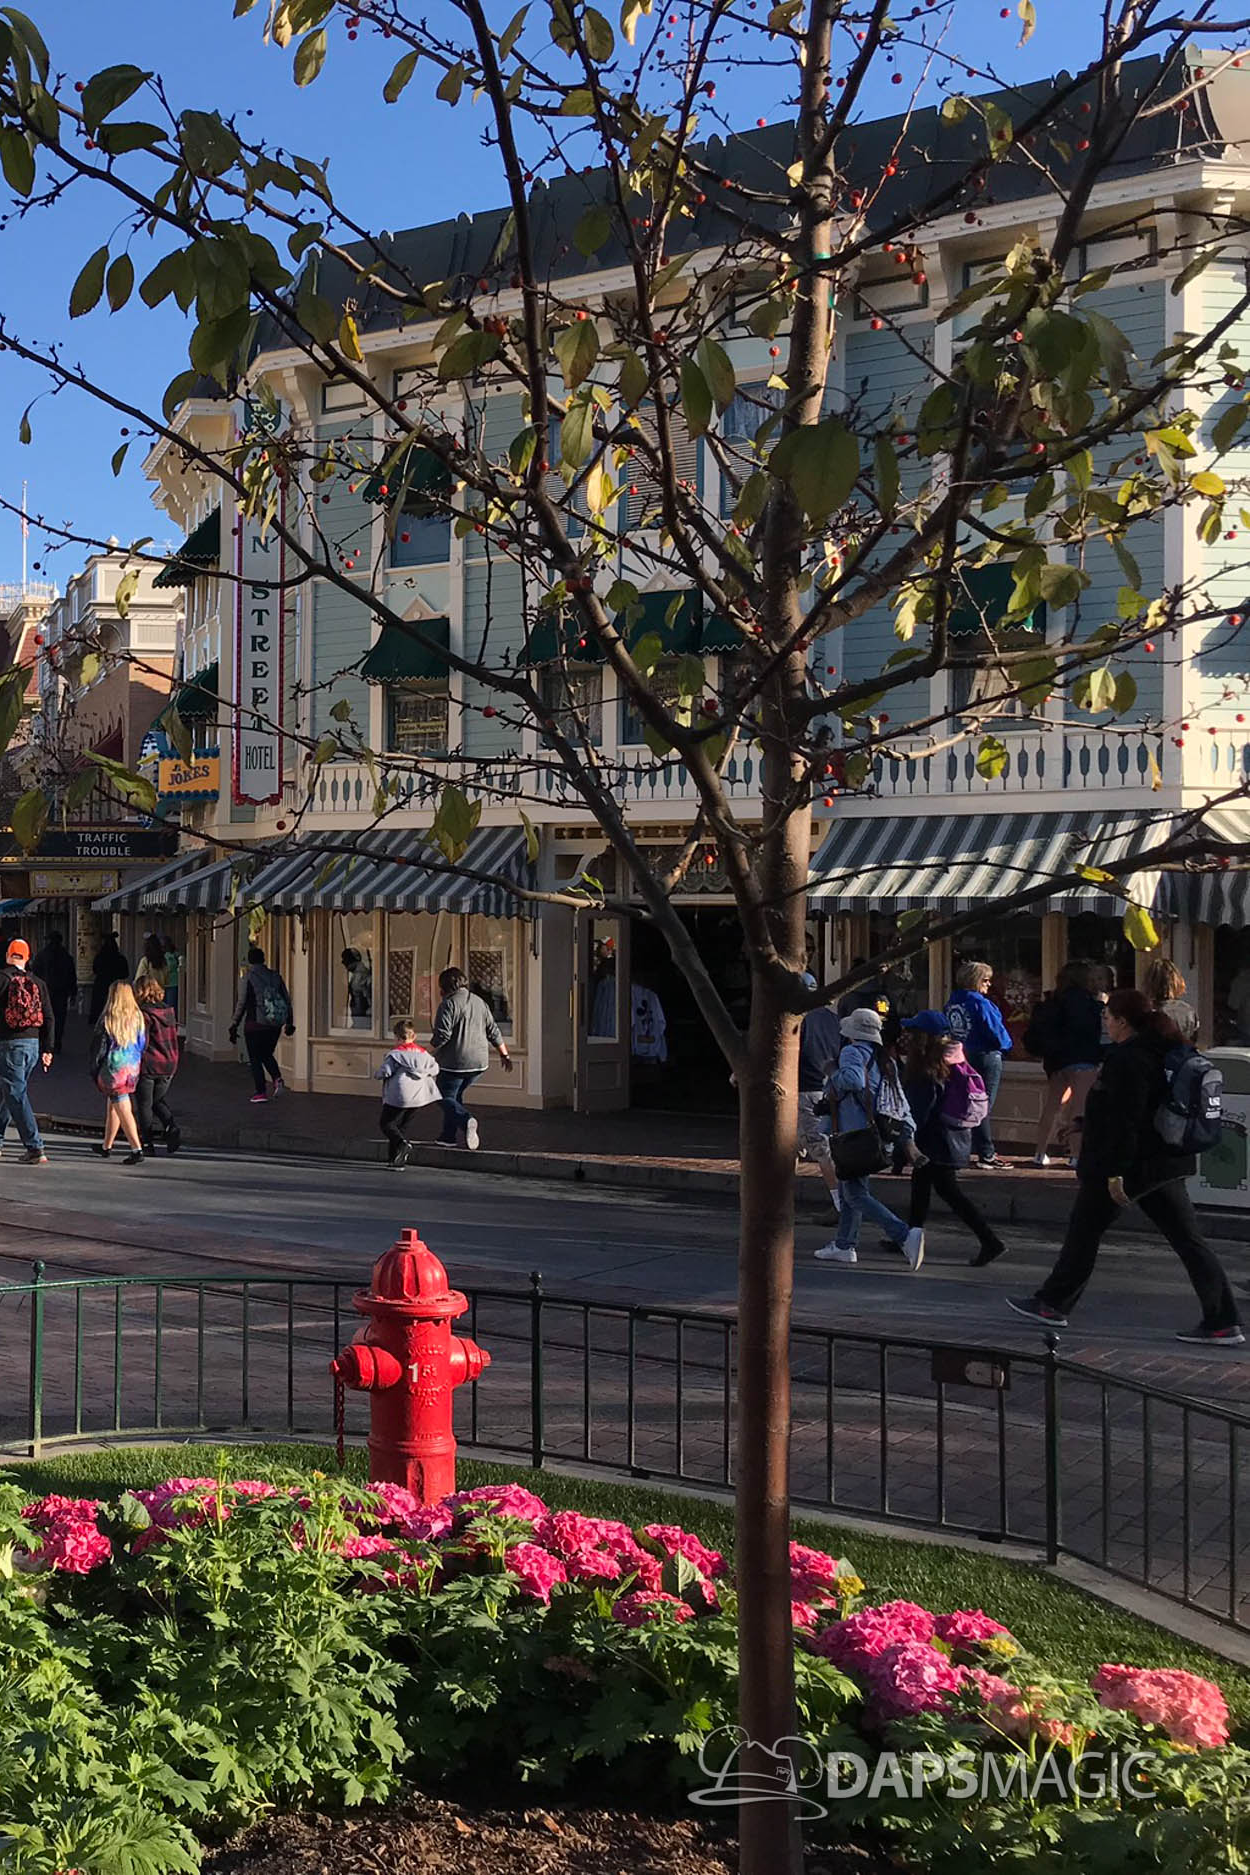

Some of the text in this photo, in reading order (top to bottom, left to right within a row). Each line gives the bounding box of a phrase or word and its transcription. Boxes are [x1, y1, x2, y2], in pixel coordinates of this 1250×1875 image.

[244, 745, 276, 770] HOTEL
[167, 764, 211, 786] JOKES
[77, 832, 128, 844] TRAFFIC
[75, 845, 132, 857] TROUBLE
[408, 1362, 419, 1383] 1
